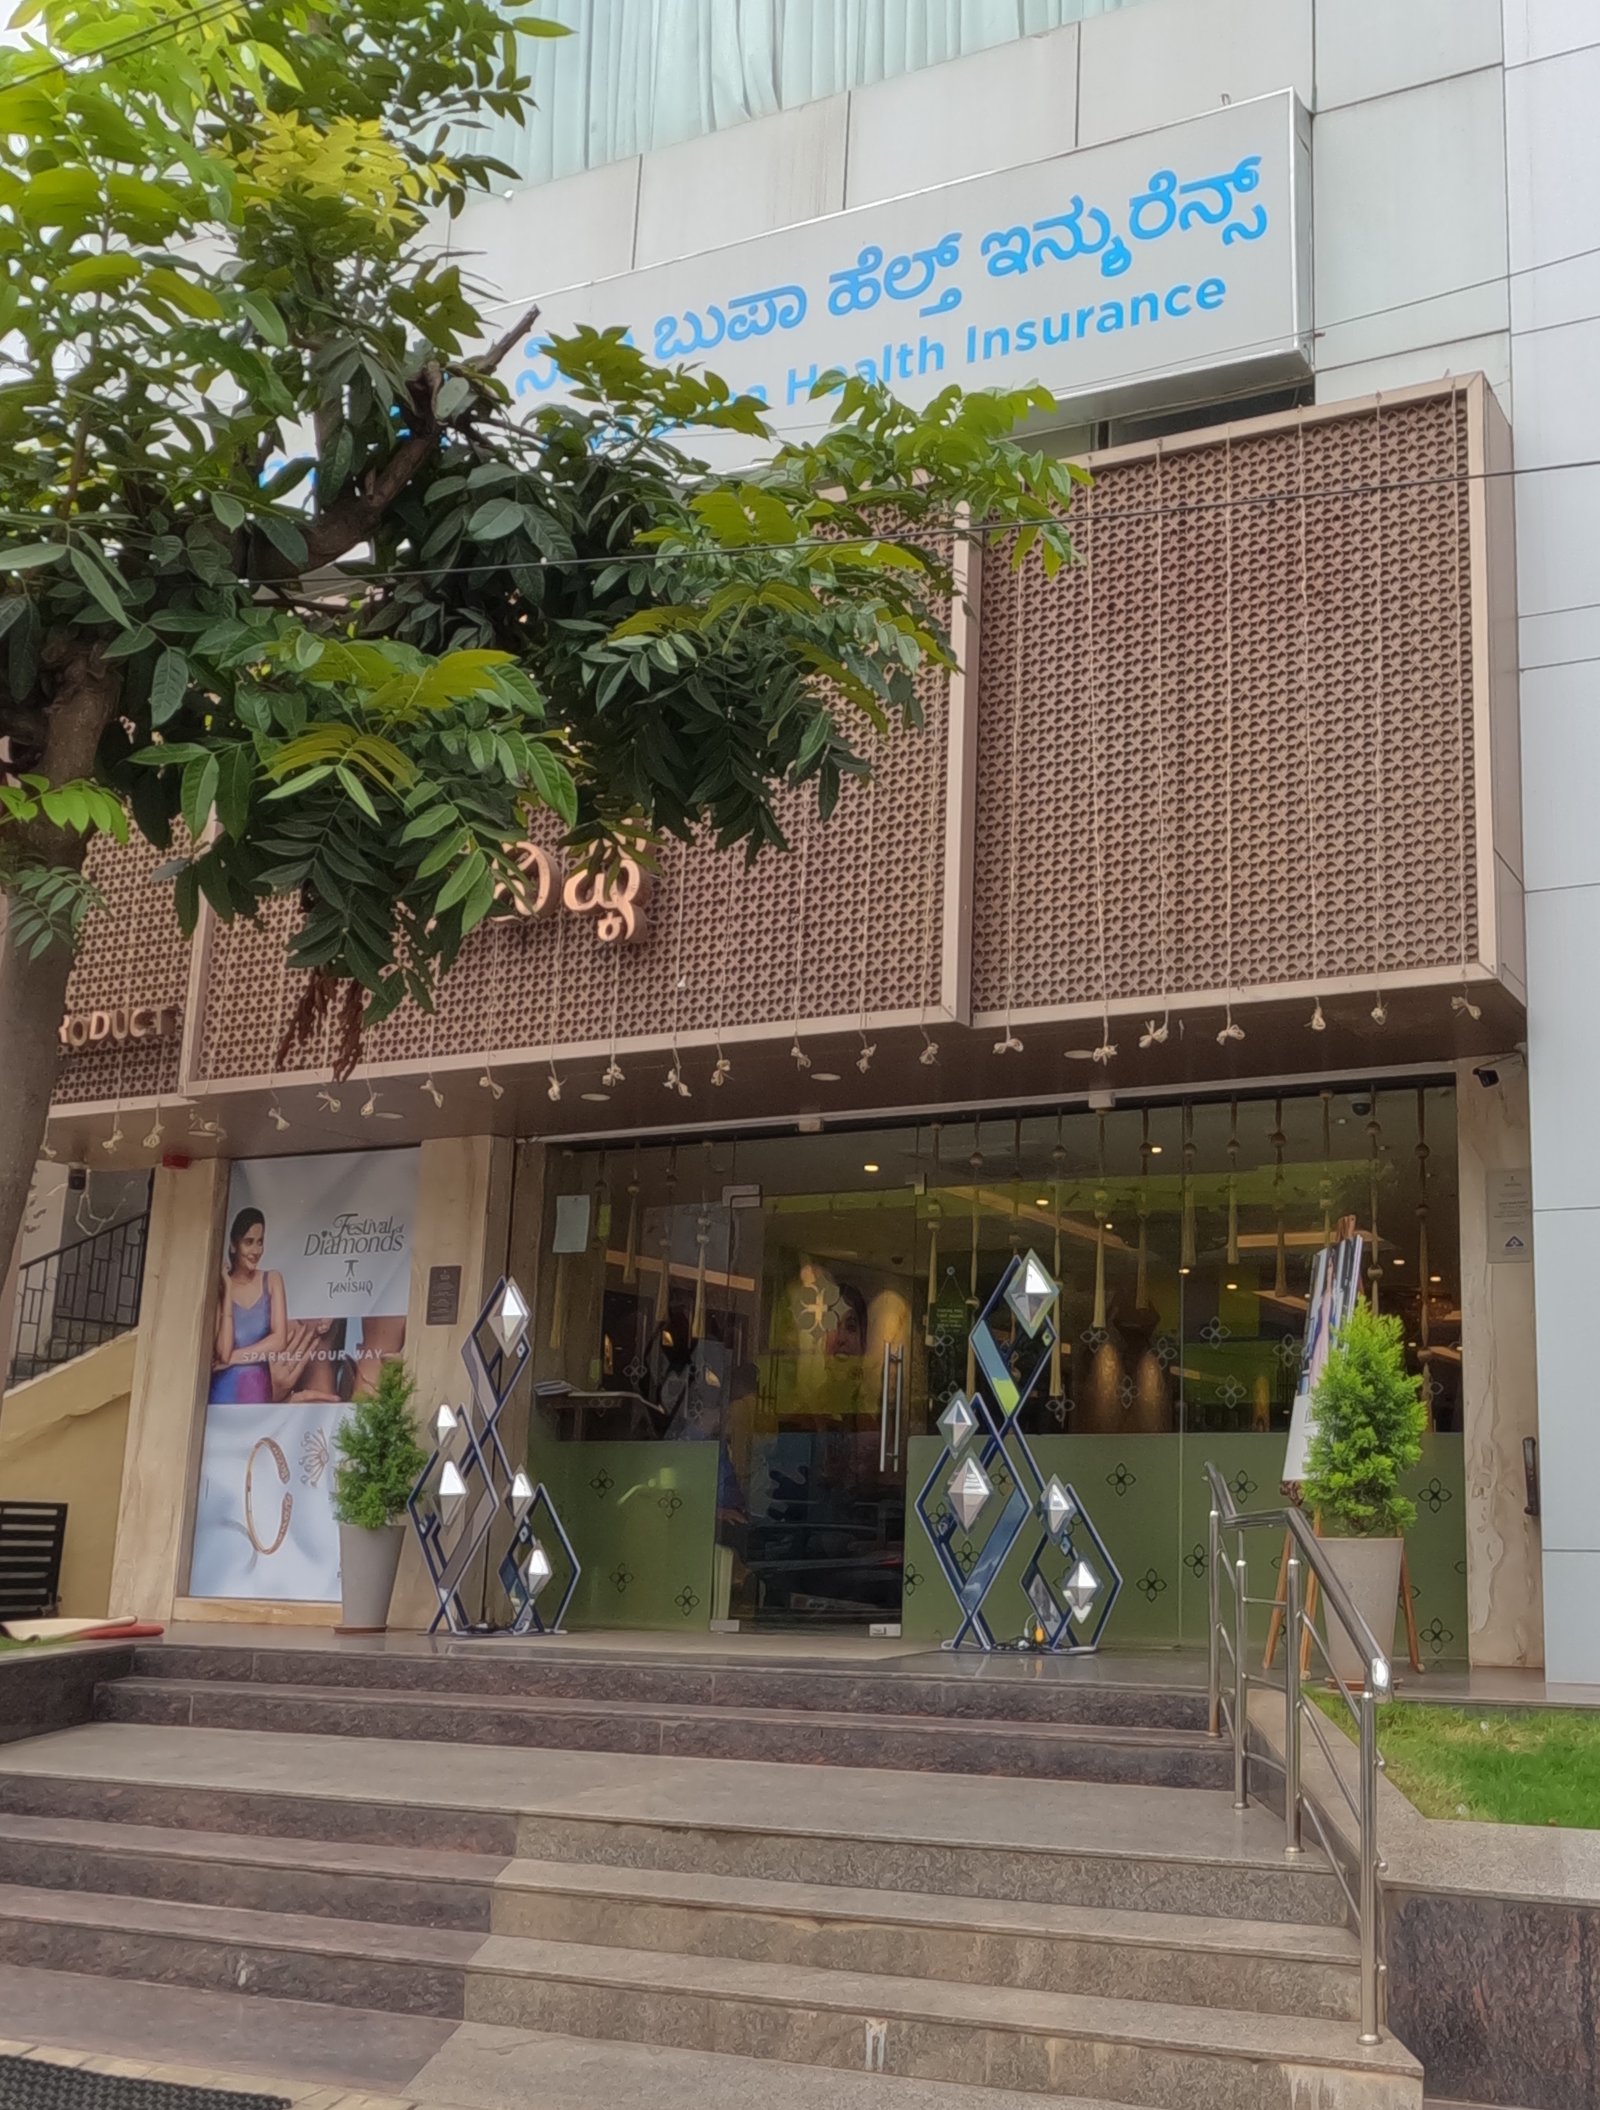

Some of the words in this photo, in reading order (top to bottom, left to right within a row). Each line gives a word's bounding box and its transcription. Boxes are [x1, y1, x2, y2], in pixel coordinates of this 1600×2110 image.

[653, 284, 808, 361] ಬುಪಾ
[827, 232, 964, 318] ಹೆಲ್ತ್
[966, 277, 1226, 364] Insurance
[329, 1213, 394, 1238] Festival
[303, 1230, 405, 1256] Diamonds
[242, 1350, 303, 1362] SPARKLE
[308, 1349, 347, 1361] YOUR
[354, 1348, 383, 1360] WAY
